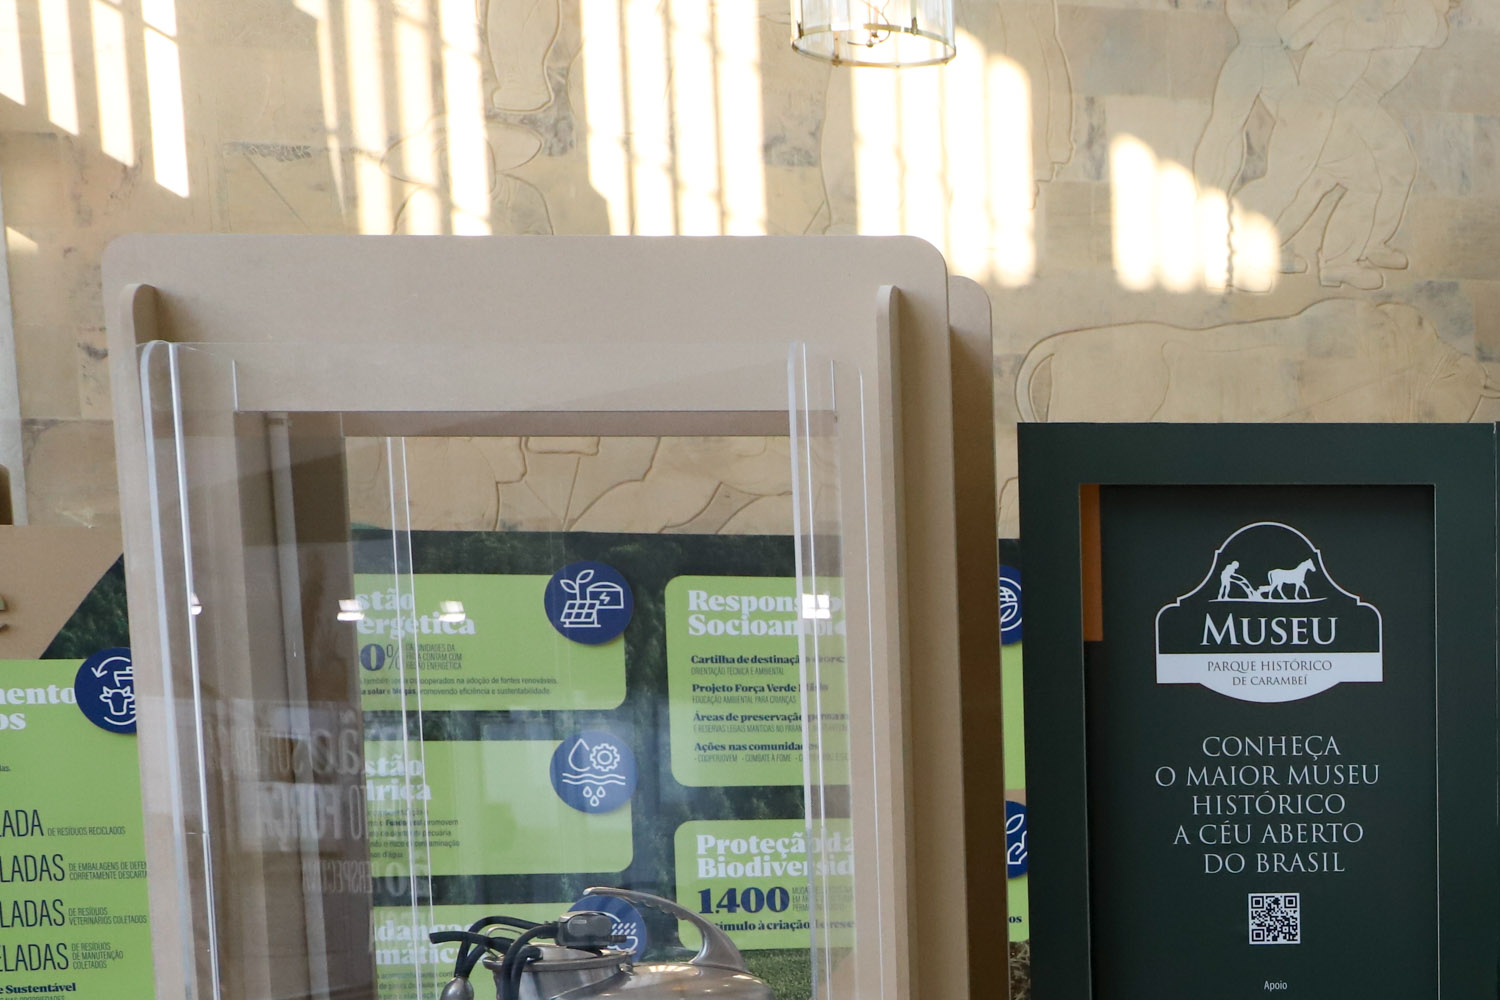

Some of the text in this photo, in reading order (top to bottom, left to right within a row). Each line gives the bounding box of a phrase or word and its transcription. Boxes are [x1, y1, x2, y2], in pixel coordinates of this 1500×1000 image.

[691, 655, 749, 666] Cartilha de
[1207, 659, 1332, 675] PARQUE HISTÓRICO
[1232, 674, 1307, 686] DE CARAMBEÍ
[692, 684, 732, 694] Projeto
[735, 684, 766, 694] Força
[767, 683, 797, 692] Verde
[693, 711, 739, 722] Áreas de
[694, 742, 747, 753] Ações nas
[1202, 735, 1341, 761] CONHEÇA
[1155, 764, 1380, 787] O MAIOR MUSEU
[1192, 791, 1345, 816] HISTÓRICO
[1173, 820, 1364, 845] A CÉU ABERTO
[1204, 852, 1345, 874] DO BRASIL
[5, 982, 76, 994] Sustentável
[1264, 980, 1288, 992] Apoio
